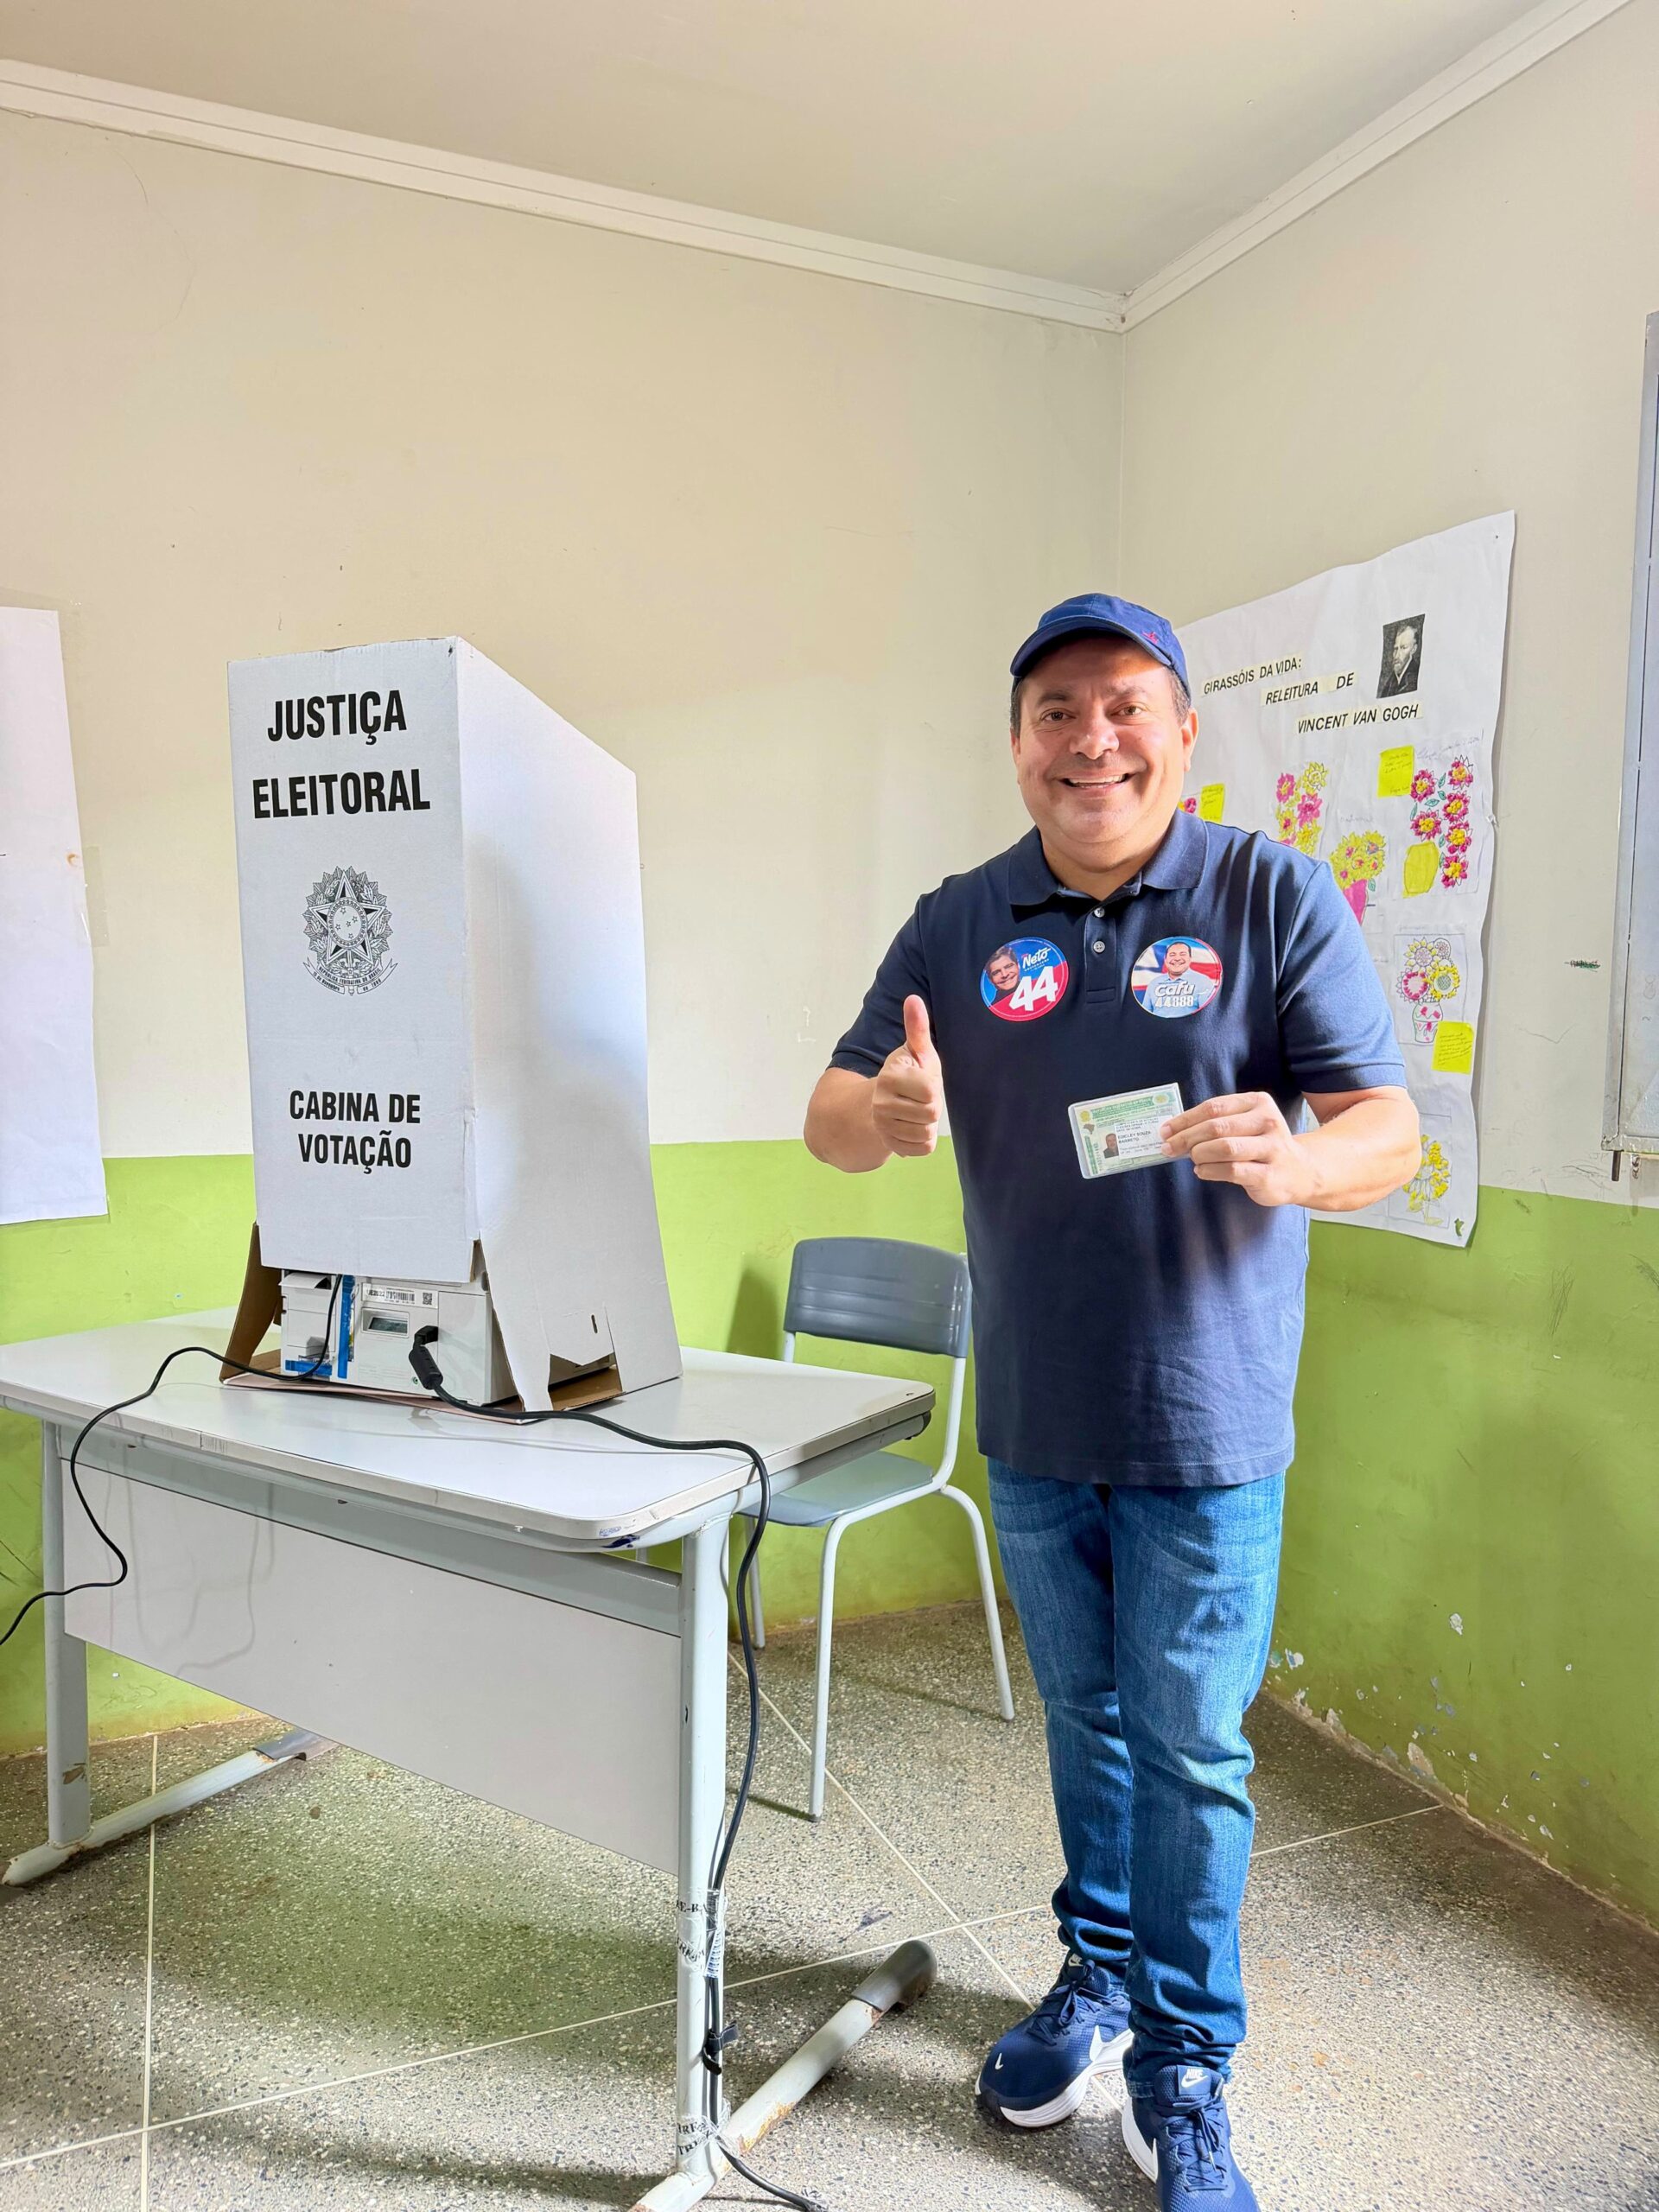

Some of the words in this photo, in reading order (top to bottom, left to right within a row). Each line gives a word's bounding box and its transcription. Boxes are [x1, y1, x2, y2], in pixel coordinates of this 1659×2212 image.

[1204, 669, 1255, 695] GIRASSÓIS
[1259, 664, 1274, 679] DA
[1275, 657, 1302, 674] VIDA:
[1265, 681, 1319, 705] RELEITURA
[1336, 672, 1355, 690] DE
[267, 690, 407, 745] JUSTIÇA
[1298, 713, 1348, 734] VINCENT
[1352, 709, 1377, 725] VAN
[1382, 703, 1419, 721] GOGH
[252, 768, 430, 819] ELEITORAL
[1022, 947, 1052, 969] Neto
[1009, 965, 1058, 1012] 44
[1154, 995, 1194, 1008] 44888
[289, 1090, 379, 1123] CABINA
[389, 1093, 421, 1124] DE
[298, 1130, 412, 1174] VOTAÇÃO
